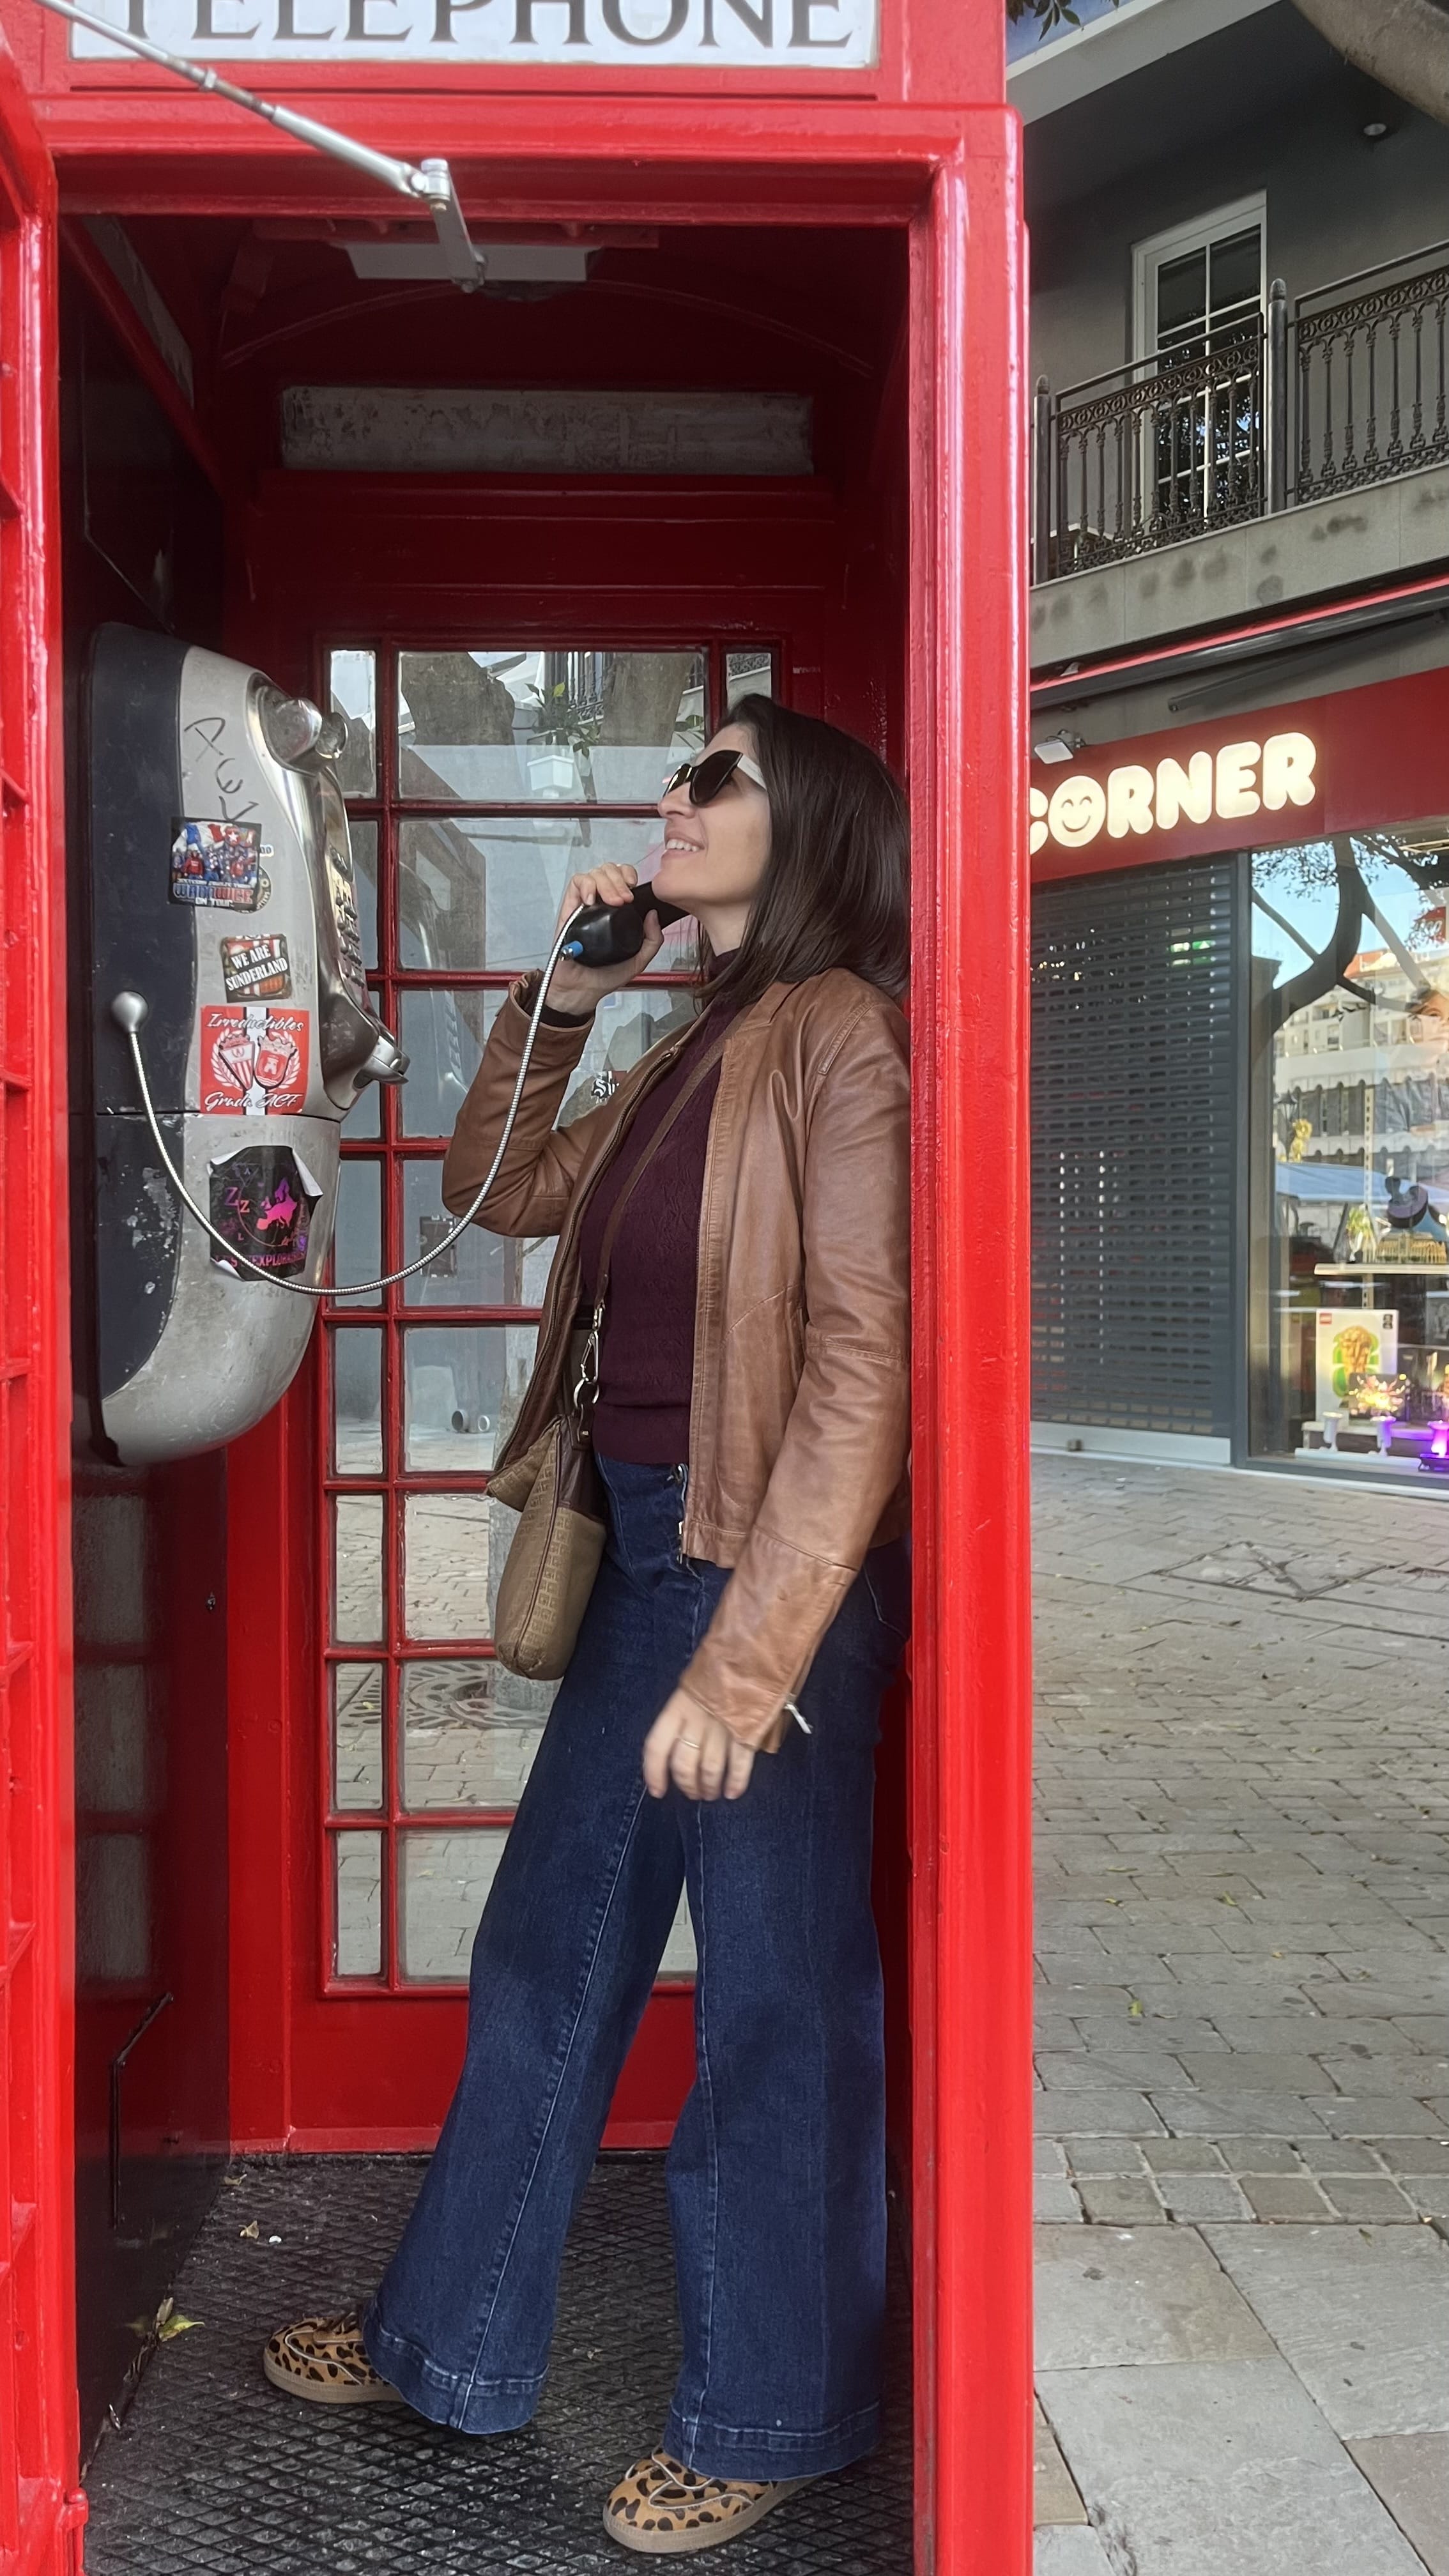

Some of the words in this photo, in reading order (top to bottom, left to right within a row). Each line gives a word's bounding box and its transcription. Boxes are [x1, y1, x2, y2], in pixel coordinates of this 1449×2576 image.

[231, 953, 249, 969] WE
[249, 944, 271, 963] ARE
[226, 958, 288, 991] SUNDERLAND
[204, 1091, 253, 1112] Grada
